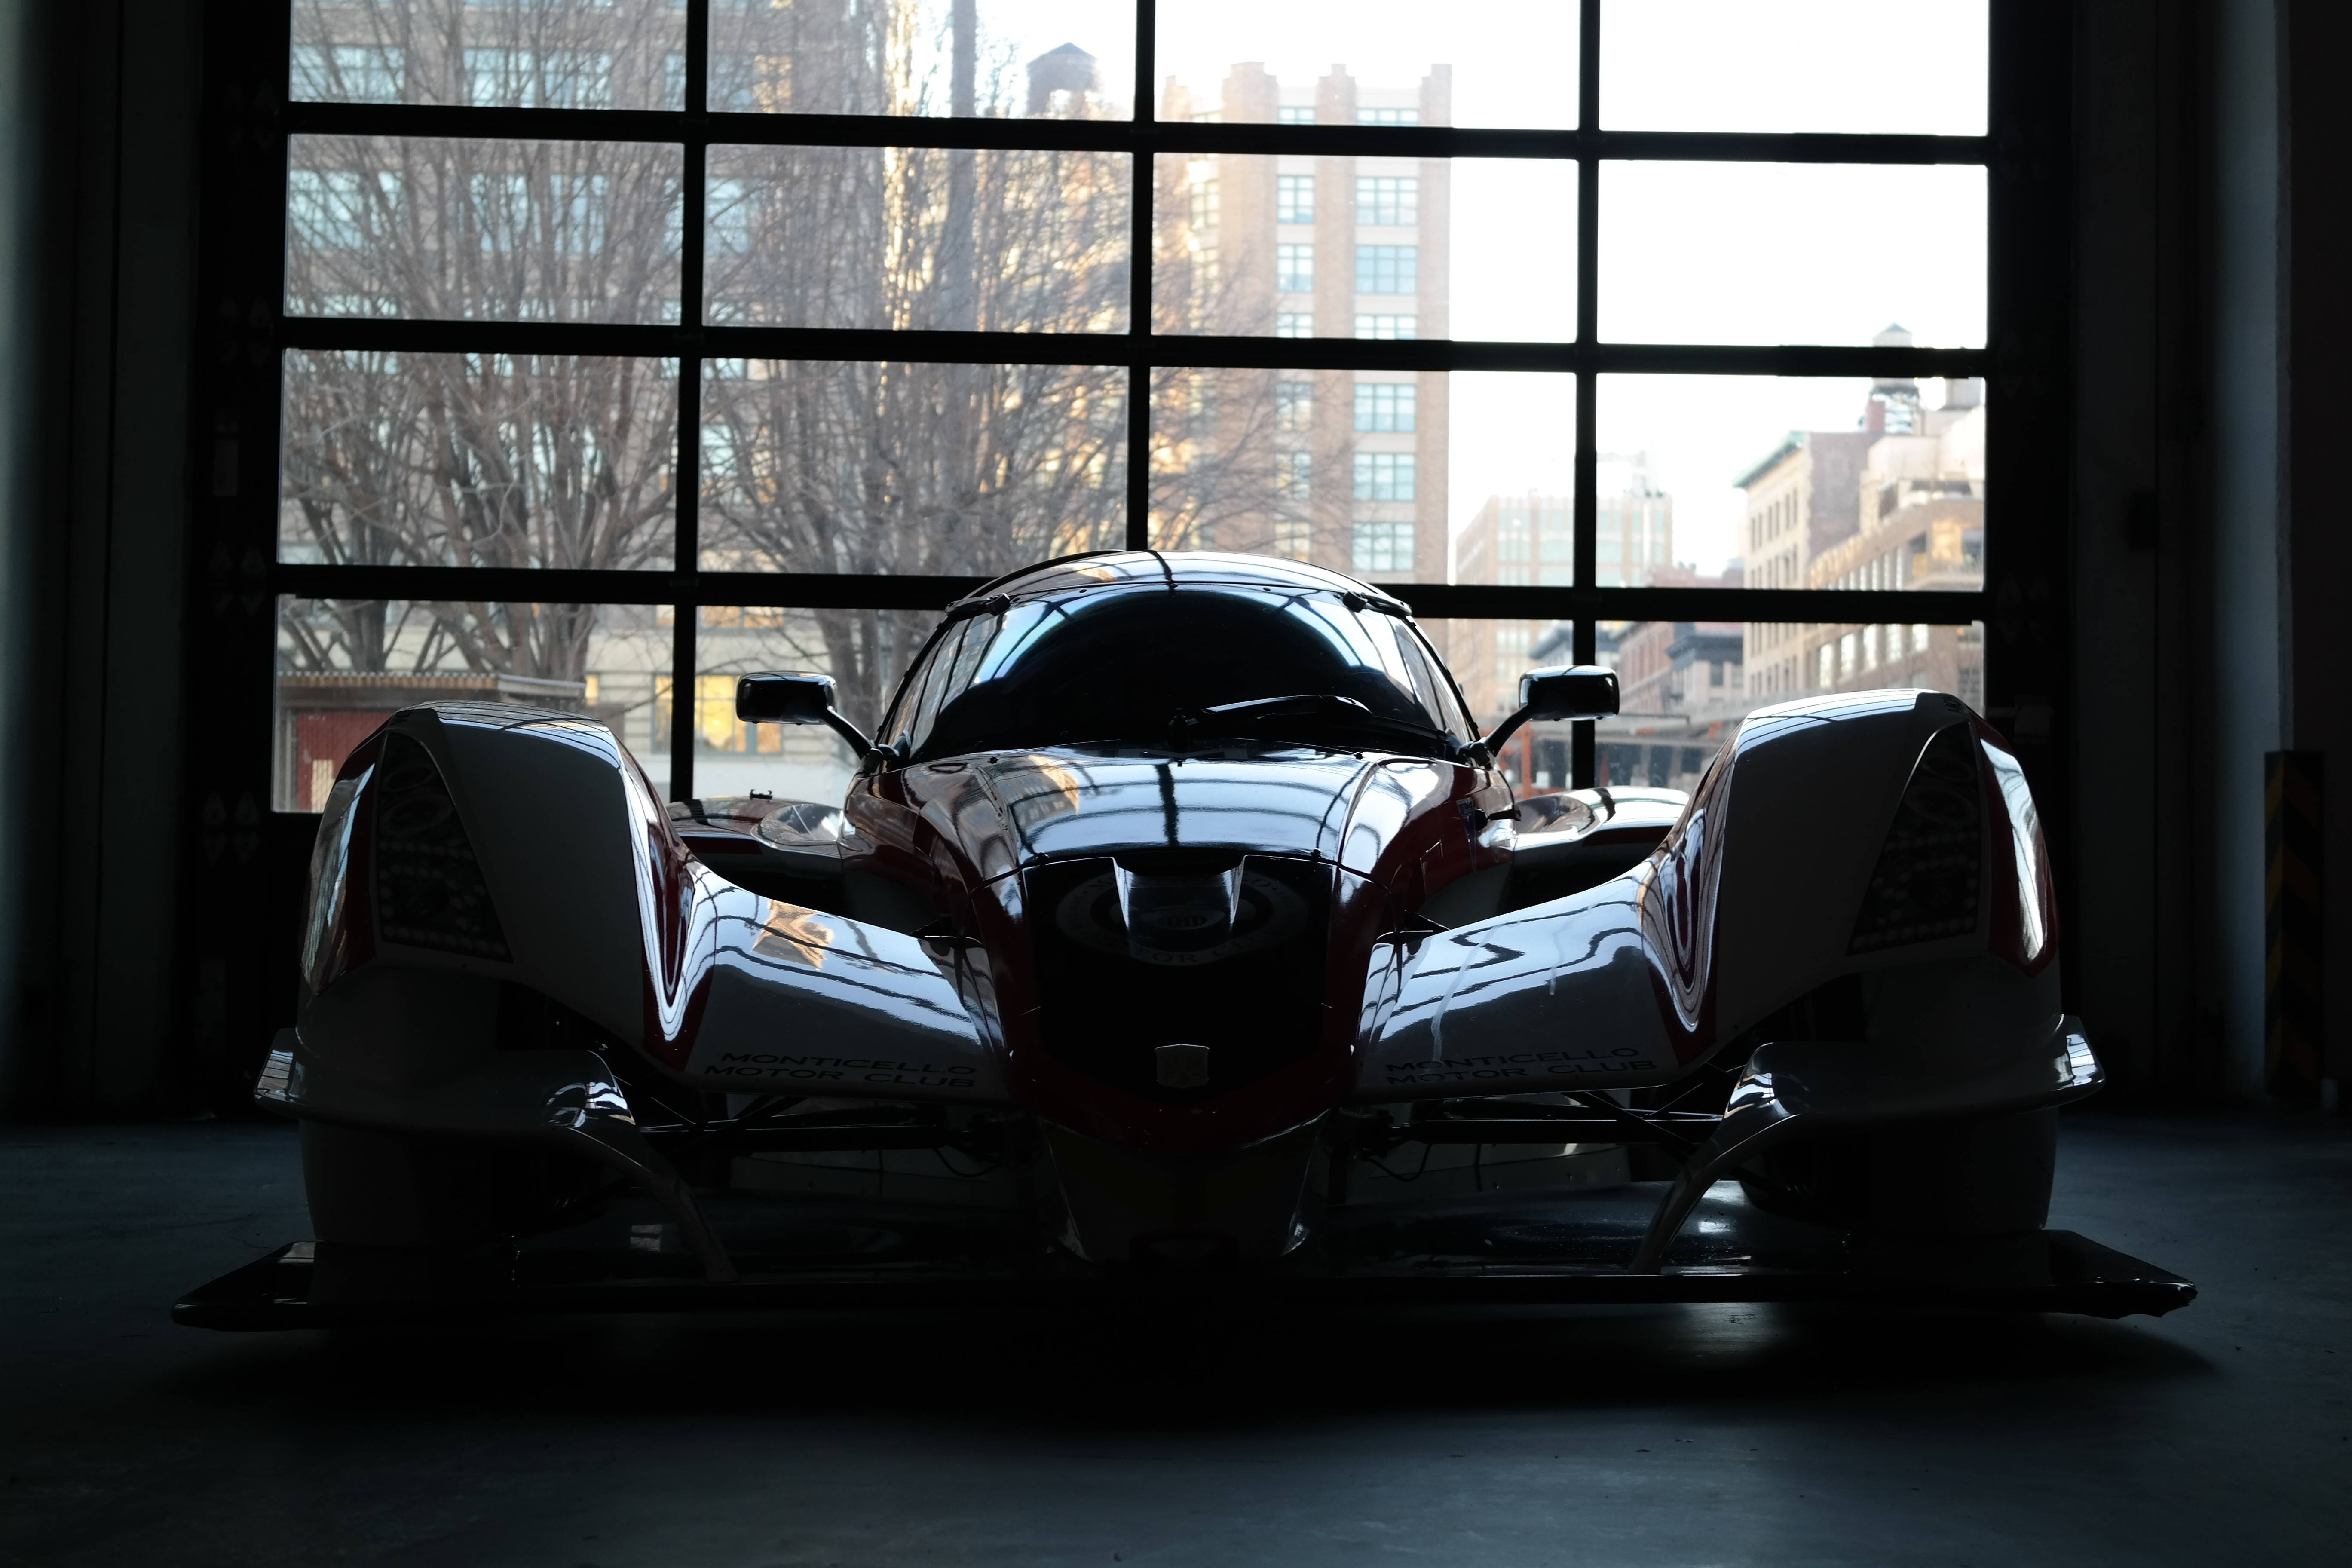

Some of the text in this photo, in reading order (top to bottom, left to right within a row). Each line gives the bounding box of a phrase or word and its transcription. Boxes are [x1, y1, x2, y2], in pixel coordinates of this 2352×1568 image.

[721, 1053, 975, 1074] MONTICELLO
[1386, 1048, 1638, 1072] MONTICELLO
[704, 1066, 975, 1087] MOTOR CLUB
[1387, 1060, 1657, 1084] MOTOR CLUB
